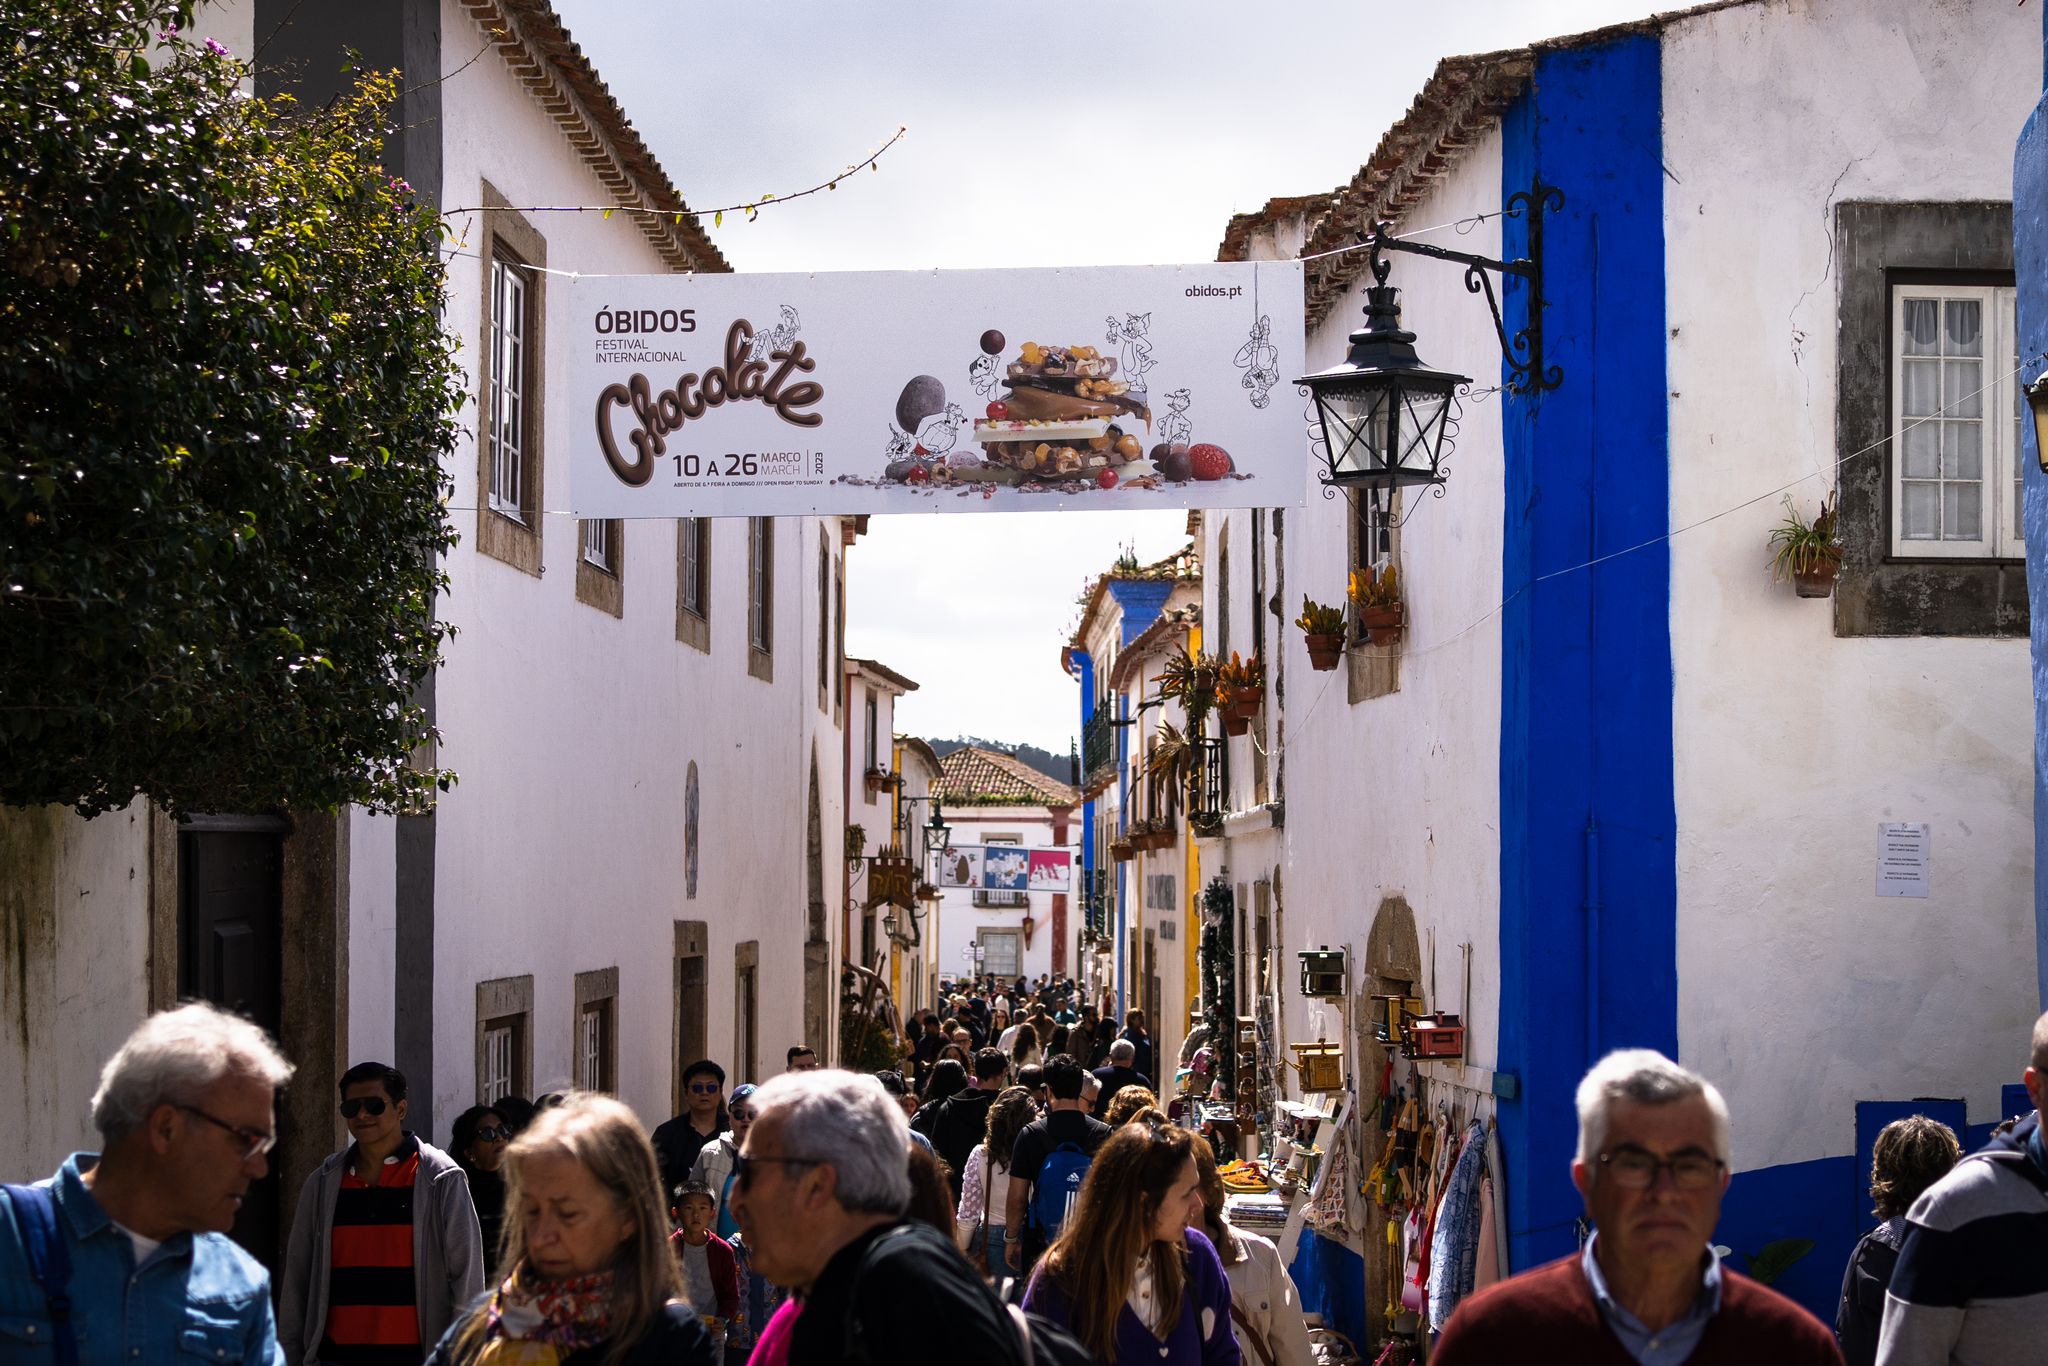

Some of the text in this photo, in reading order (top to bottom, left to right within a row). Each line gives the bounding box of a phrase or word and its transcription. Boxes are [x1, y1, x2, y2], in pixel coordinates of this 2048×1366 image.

[1185, 284, 1243, 300] obidos.pt
[594, 304, 697, 334] ÓBIDOS
[595, 338, 649, 350] FESTIVAL
[595, 351, 687, 363] INTERNACIONAL
[594, 318, 824, 488] Chocolate
[672, 453, 758, 477] 10 A 26
[760, 452, 801, 465] MARÇO
[815, 451, 824, 475] 2023
[760, 464, 801, 476] MARCH
[869, 870, 910, 898] BAR
